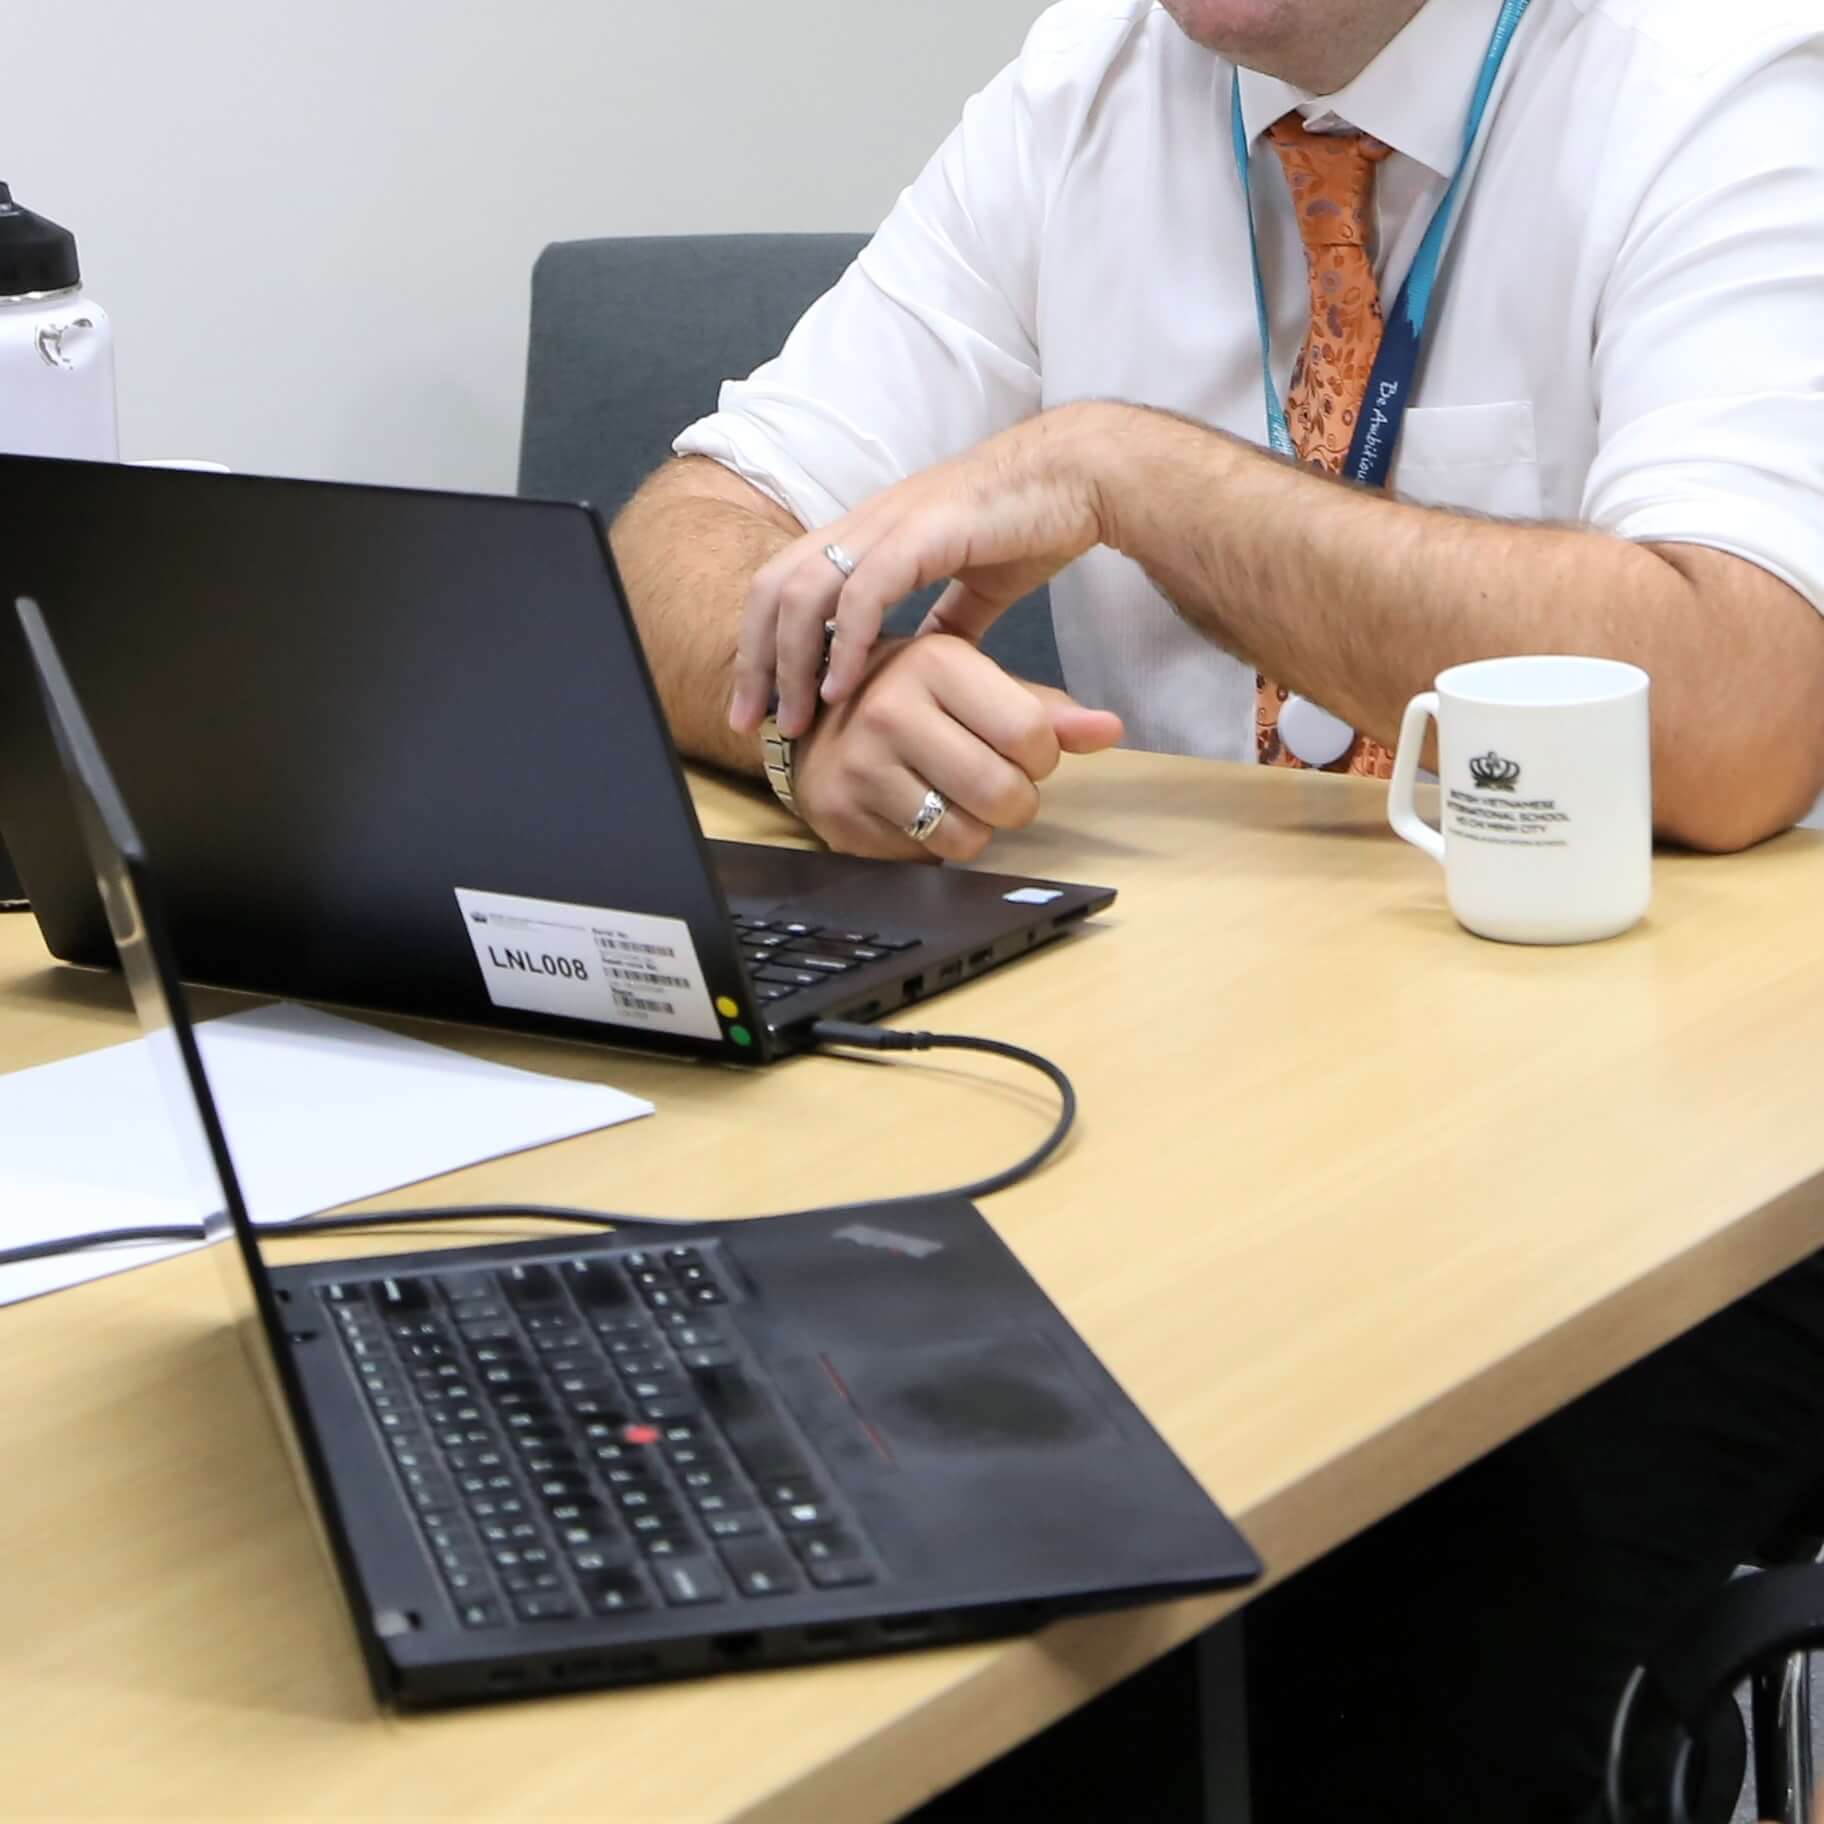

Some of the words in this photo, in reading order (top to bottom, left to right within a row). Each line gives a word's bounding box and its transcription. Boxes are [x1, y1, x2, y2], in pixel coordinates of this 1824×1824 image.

[1376, 381, 1398, 406] Be
[1357, 407, 1388, 479] Ambitiou
[1481, 798, 1554, 810] VIETNAMESE
[1519, 812, 1570, 823] SCHOOL
[1519, 824, 1546, 834] CITY
[488, 945, 588, 981] LNL008
